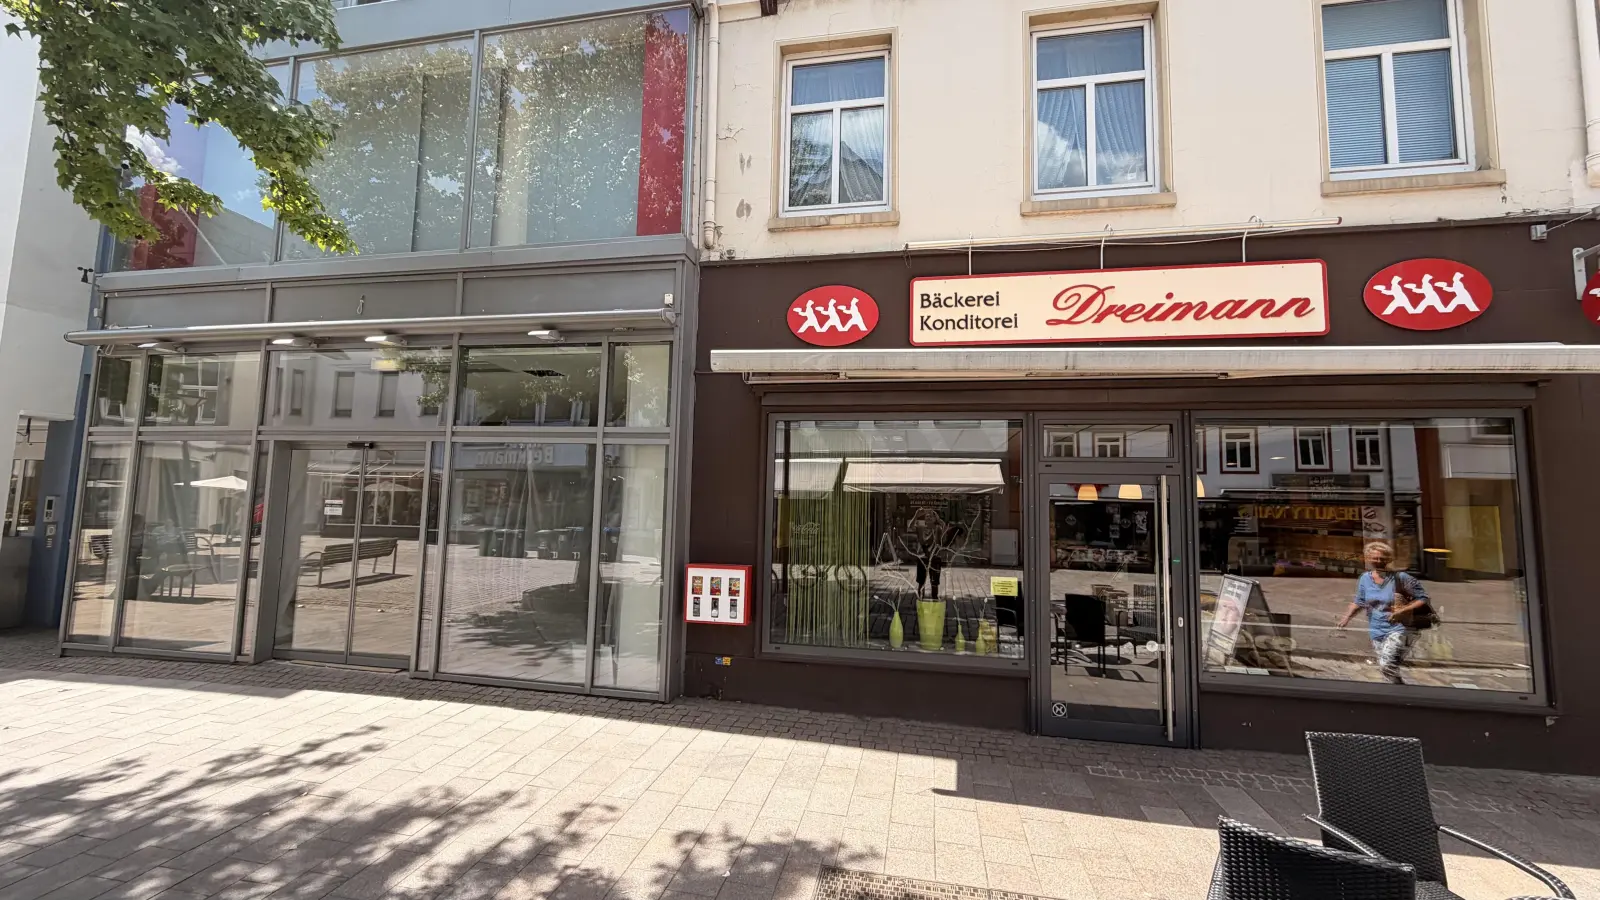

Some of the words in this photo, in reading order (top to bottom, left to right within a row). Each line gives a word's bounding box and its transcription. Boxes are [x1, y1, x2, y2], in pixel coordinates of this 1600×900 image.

[920, 291, 1000, 309] Bäckerei
[1045, 284, 1315, 326] Dreimann
[920, 313, 1018, 331] Konditorei
